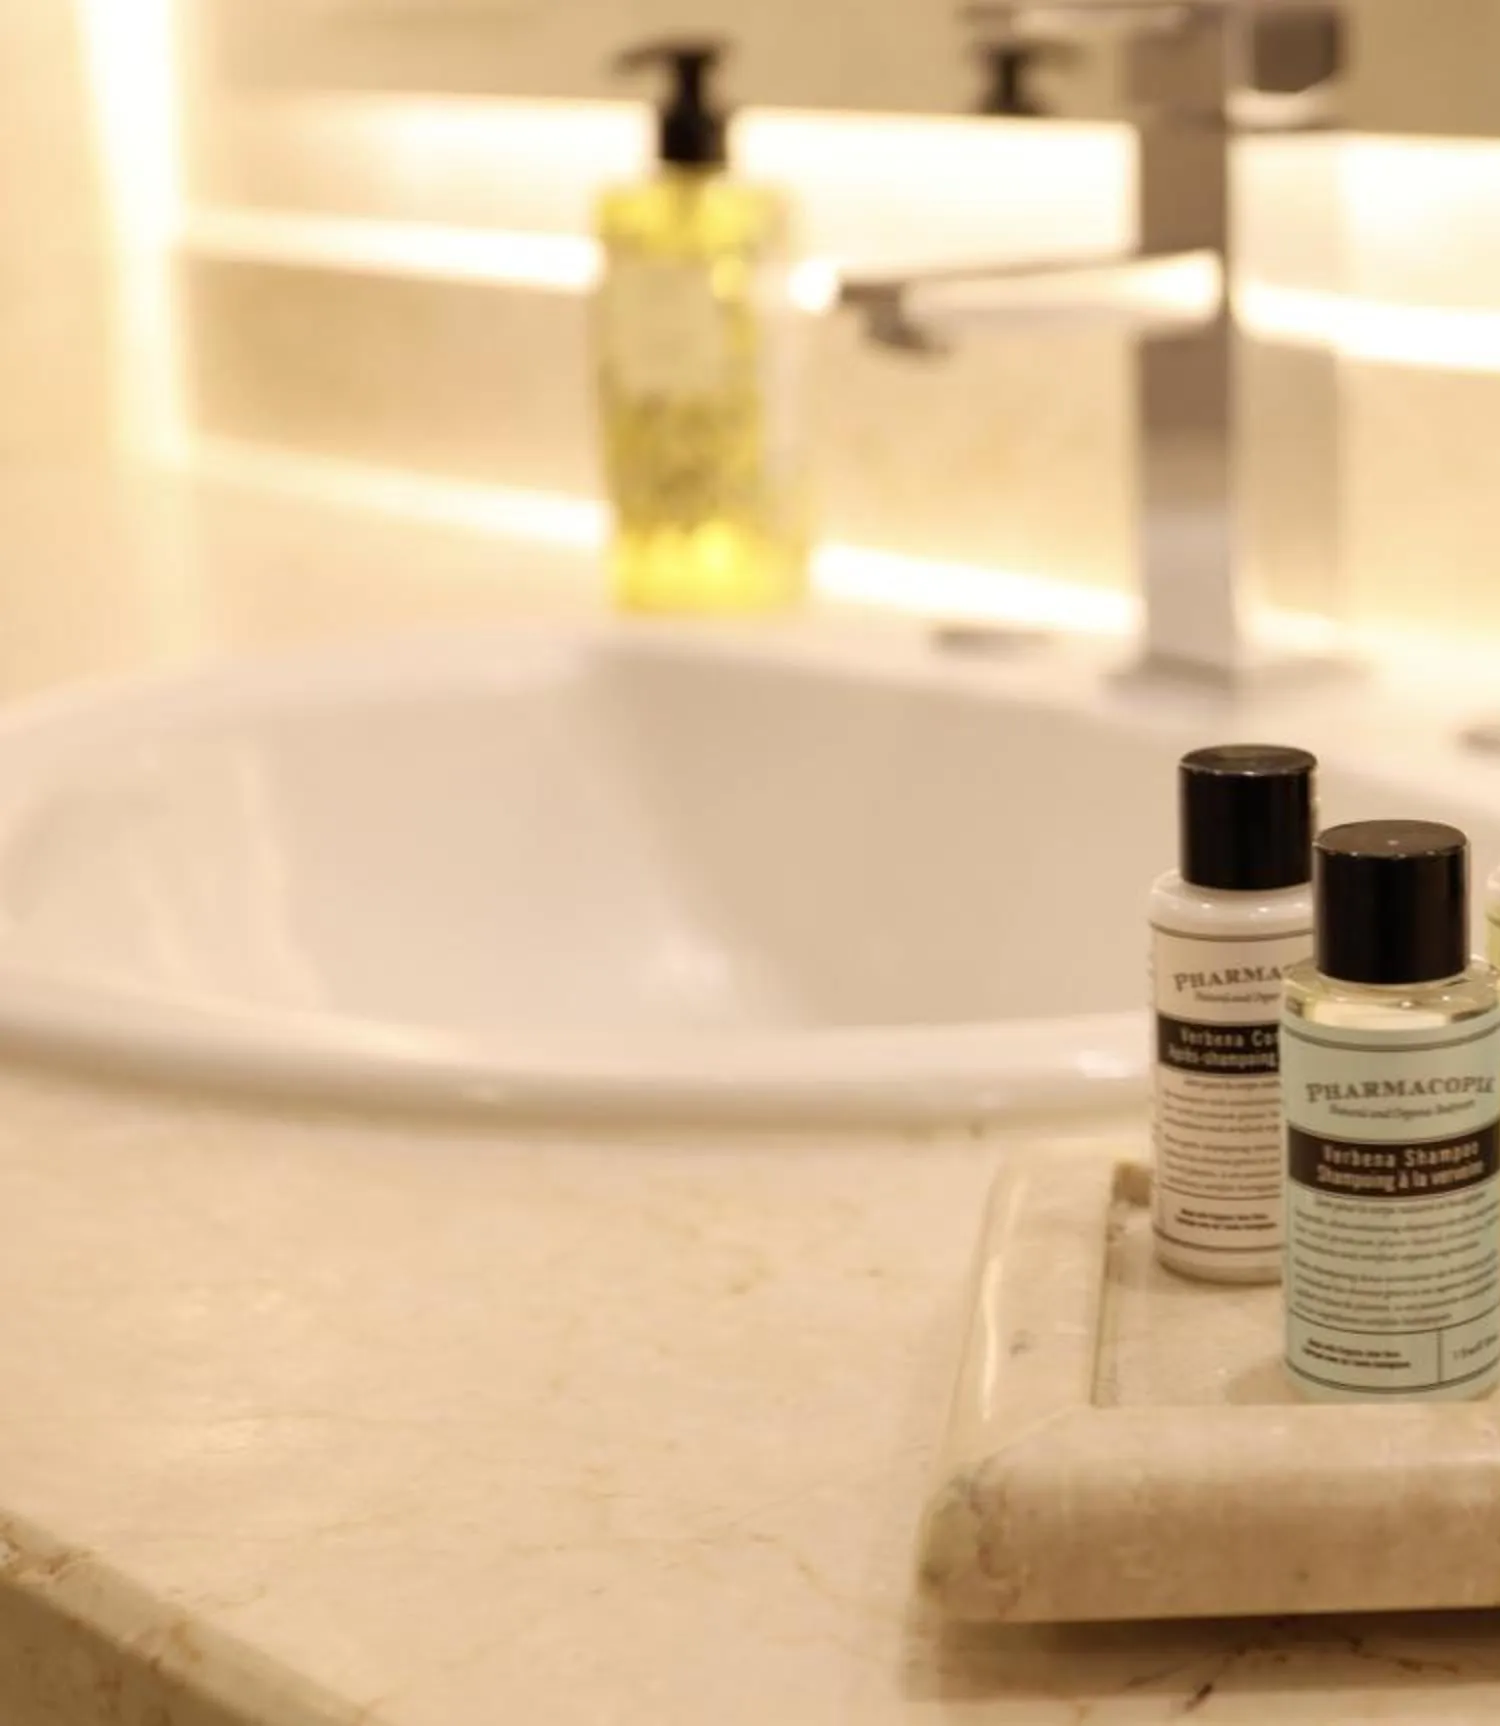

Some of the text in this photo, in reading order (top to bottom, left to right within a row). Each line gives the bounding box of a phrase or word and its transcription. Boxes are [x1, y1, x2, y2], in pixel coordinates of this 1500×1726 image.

[1172, 966, 1281, 992] PHARMA
[1321, 1140, 1480, 1169] Verbena Shampoo
